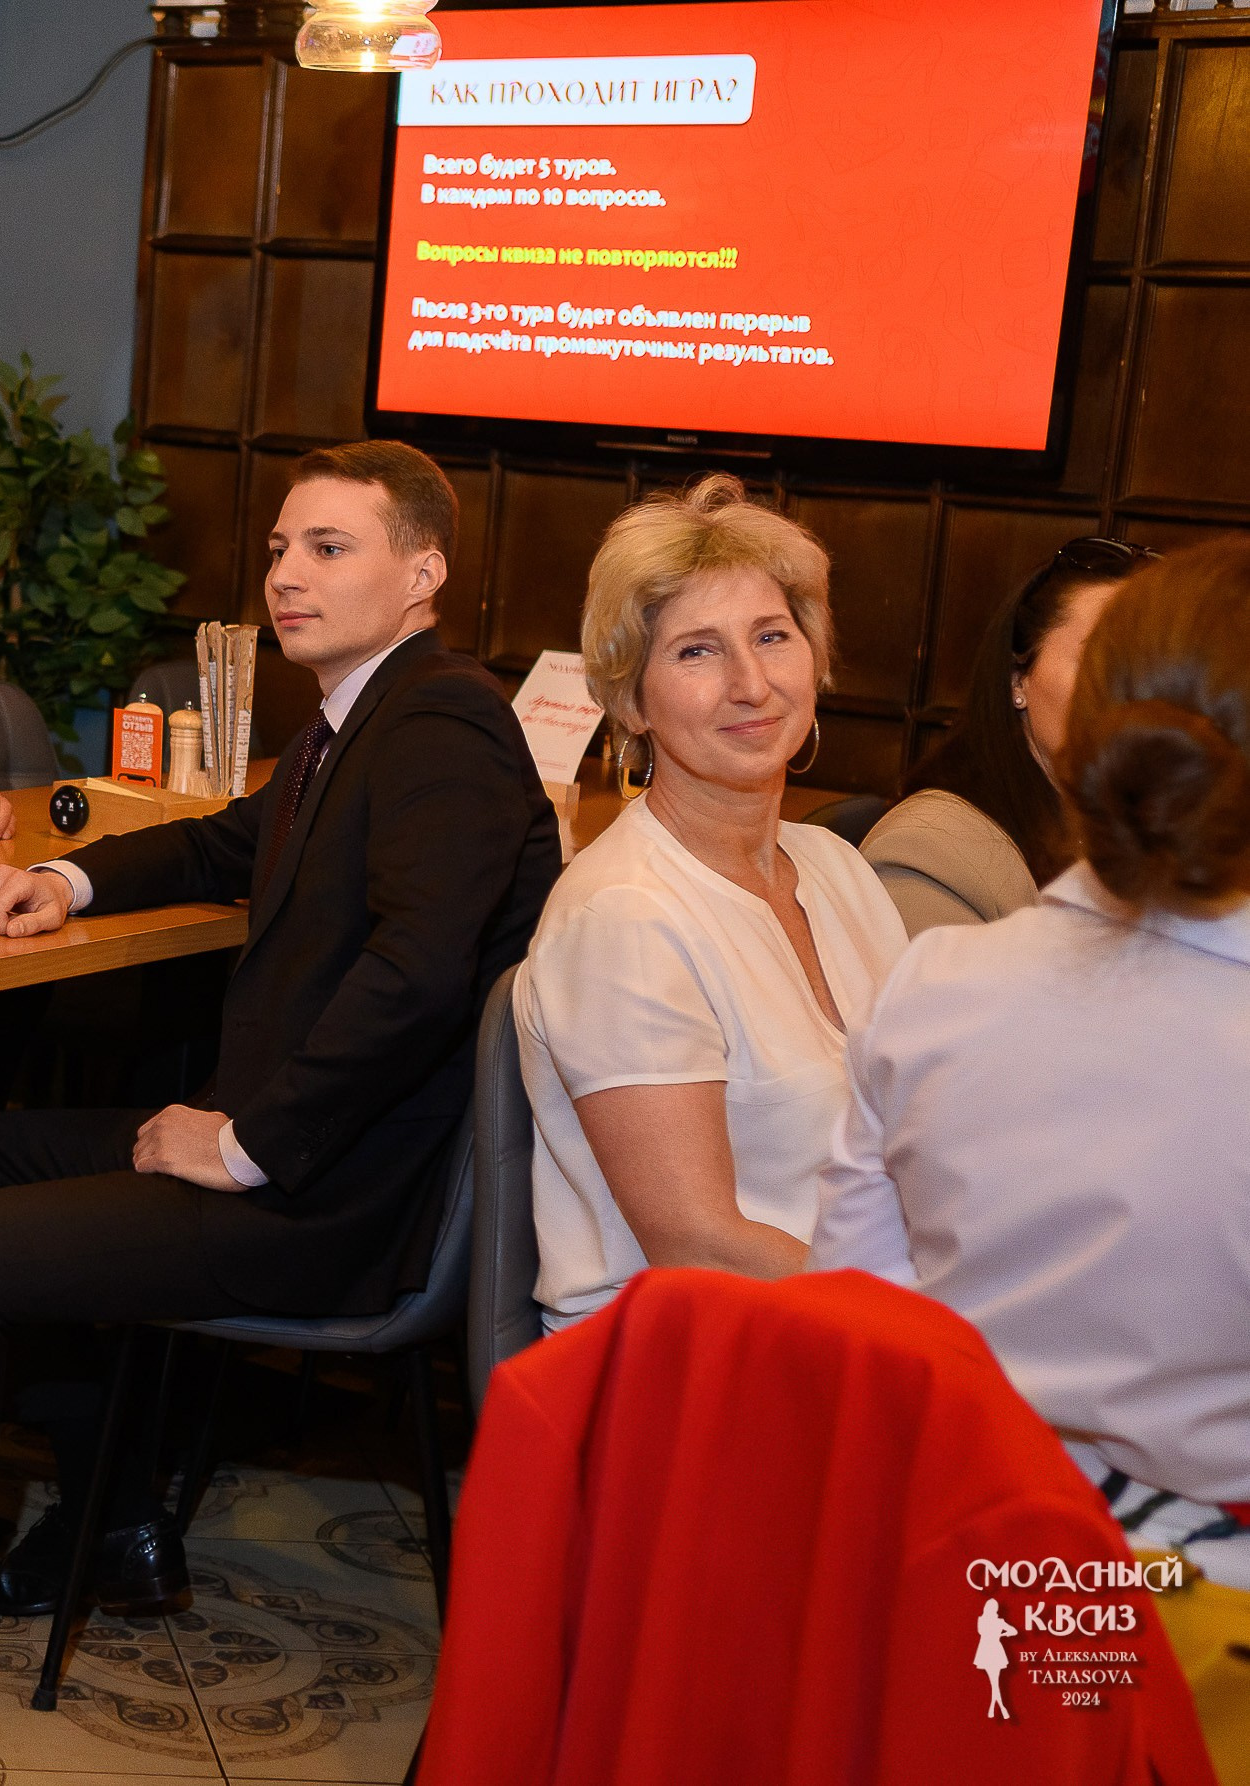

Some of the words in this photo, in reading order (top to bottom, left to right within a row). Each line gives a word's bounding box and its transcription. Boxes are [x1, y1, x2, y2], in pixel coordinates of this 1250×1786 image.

[431, 80, 478, 104] КАК
[489, 79, 644, 107] ПРОХОДИТ
[653, 78, 737, 103] ИГРА?
[423, 153, 477, 175] Всего
[479, 153, 536, 180] будет
[538, 157, 551, 179] 5
[553, 158, 617, 181] туров.
[420, 183, 435, 204] В
[437, 187, 512, 209] каждом
[514, 188, 540, 205] по
[543, 187, 563, 205] 10
[566, 189, 666, 212] вопросов.
[416, 240, 499, 267] Вопросы
[501, 246, 556, 264] квиза
[558, 248, 584, 265] не
[586, 247, 738, 272] повторяются!!!
[412, 297, 468, 319] После
[469, 302, 508, 324] 3-го
[510, 304, 554, 327] тура
[557, 302, 616, 329] будет
[618, 304, 717, 329] объявлен
[719, 312, 811, 337] перерыв
[408, 330, 444, 351] для
[446, 329, 532, 354] подсчёта
[534, 335, 696, 361] промежуточных
[698, 342, 834, 367] результатов.
[122, 721, 153, 733] ОТЗЫВ
